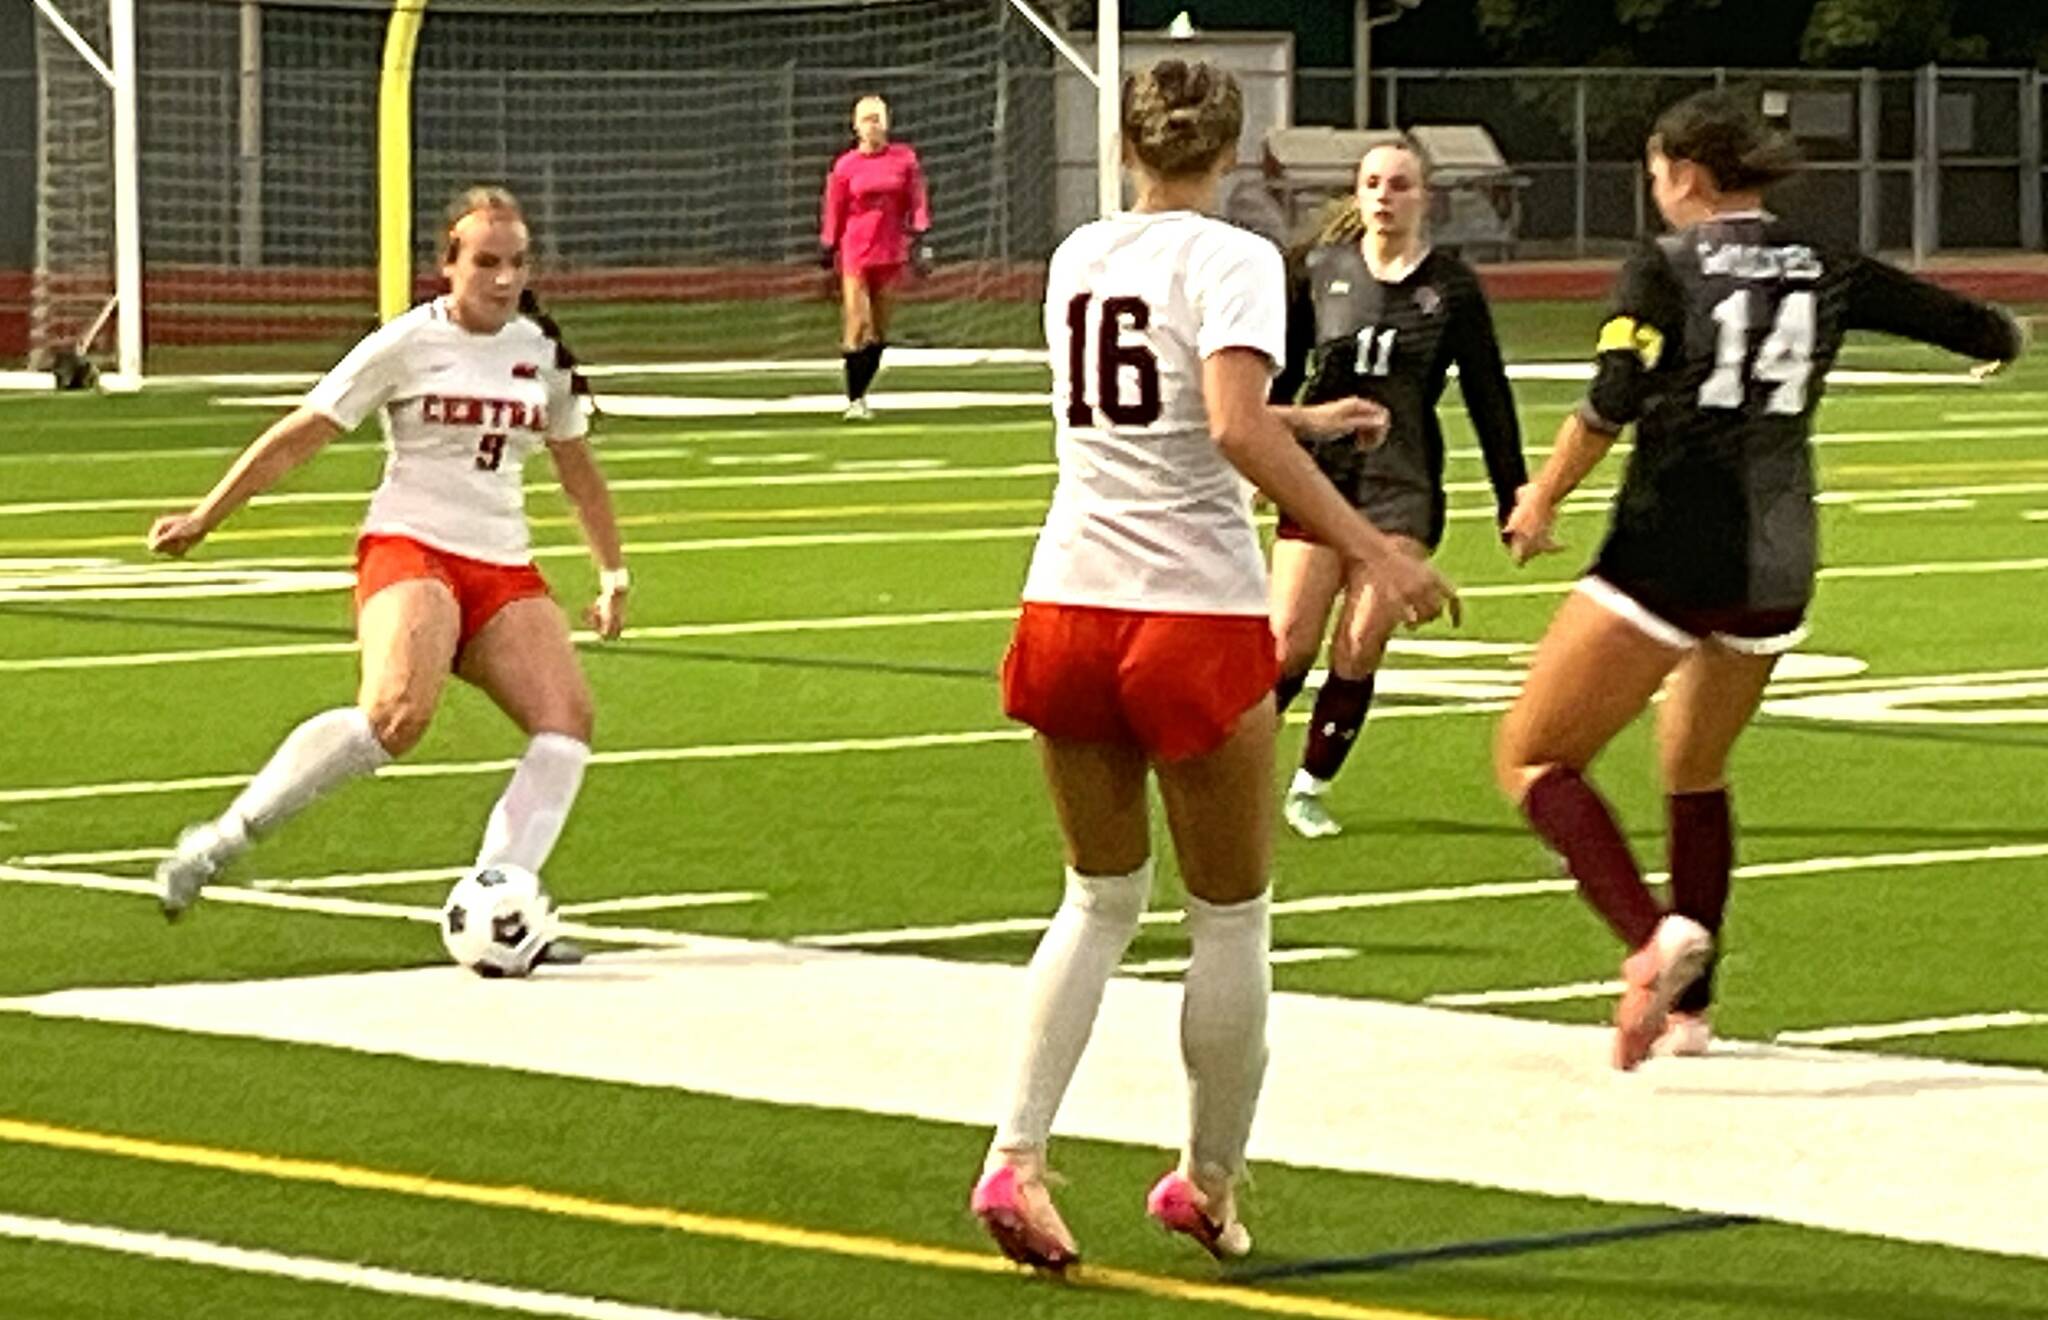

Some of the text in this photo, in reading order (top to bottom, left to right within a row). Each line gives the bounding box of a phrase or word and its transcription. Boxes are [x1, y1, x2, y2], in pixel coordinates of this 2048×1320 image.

[1066, 292, 1162, 427] 16
[1354, 326, 1397, 376] 11
[1698, 290, 1816, 414] 14
[424, 395, 548, 431] CENTRA
[475, 434, 506, 471] 9
